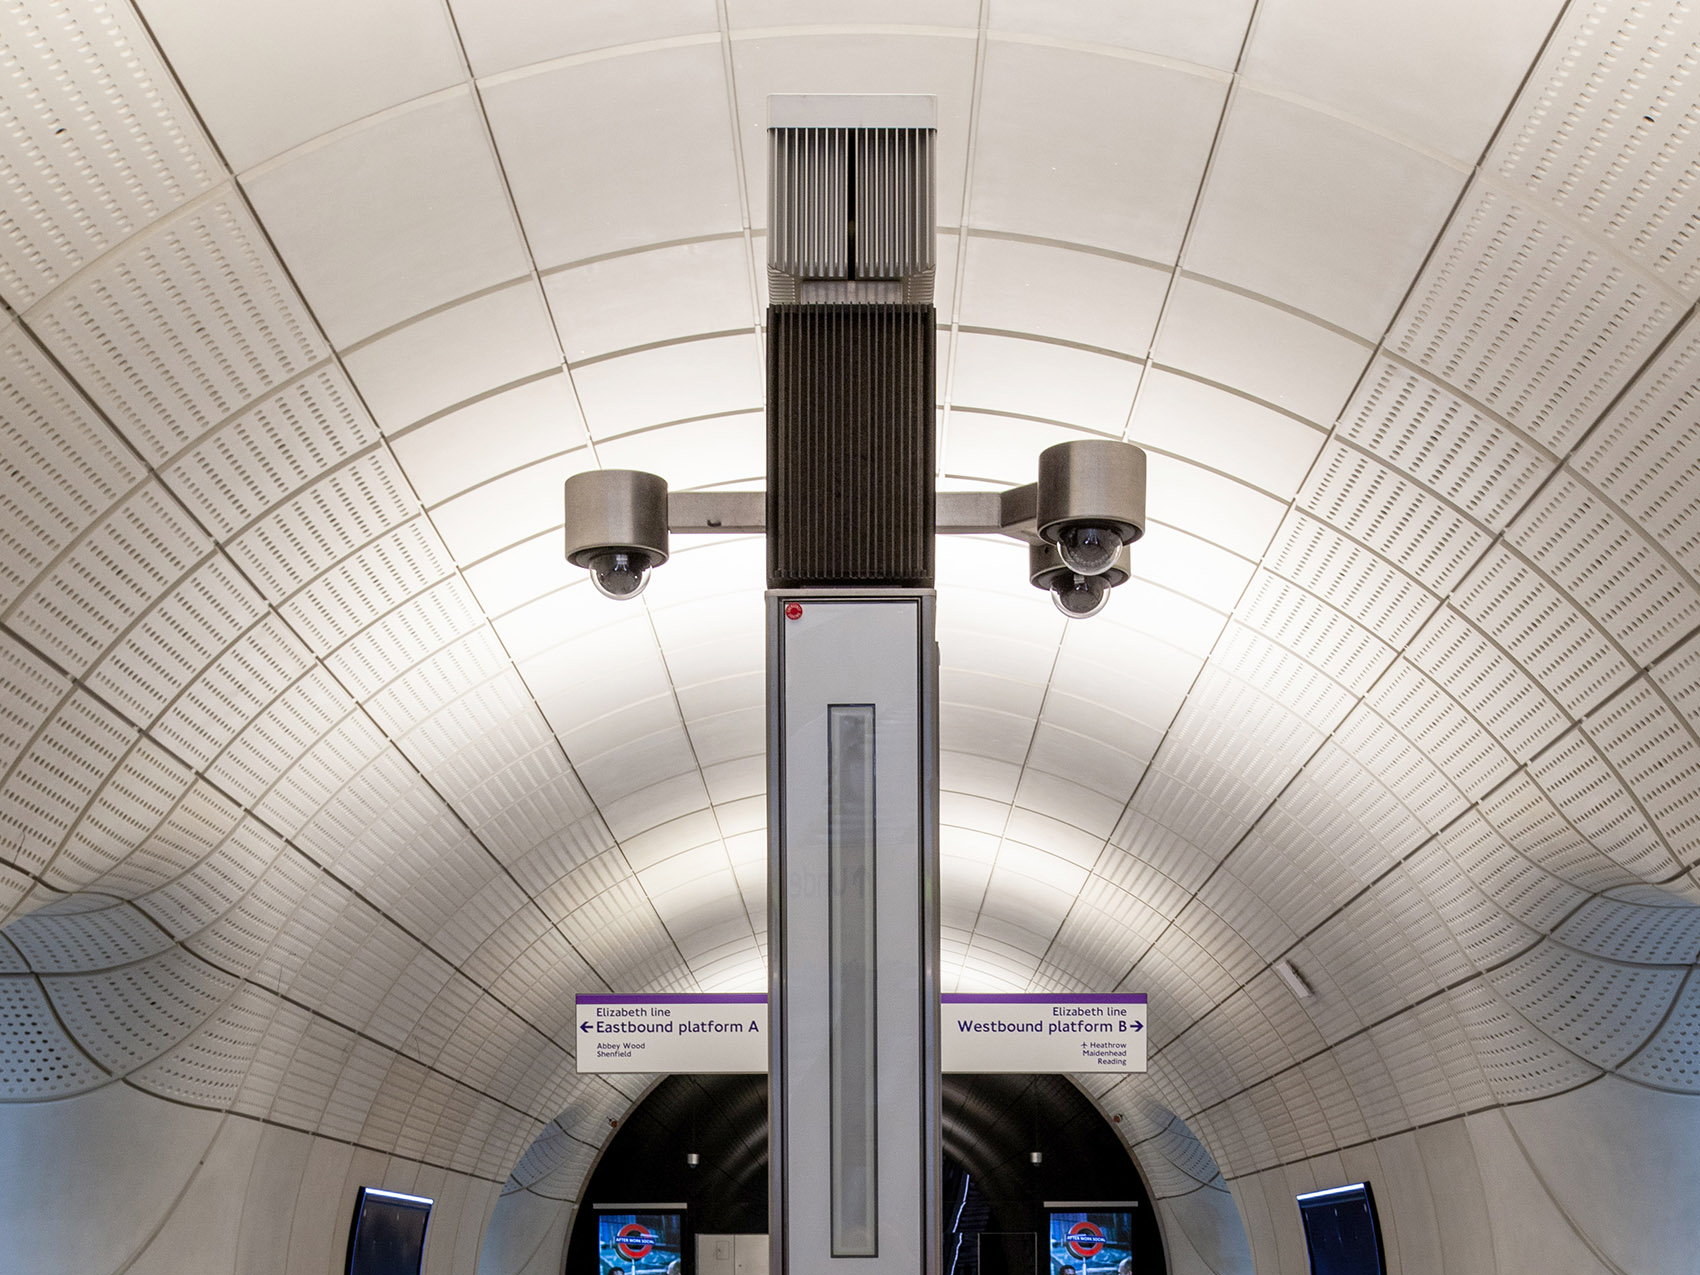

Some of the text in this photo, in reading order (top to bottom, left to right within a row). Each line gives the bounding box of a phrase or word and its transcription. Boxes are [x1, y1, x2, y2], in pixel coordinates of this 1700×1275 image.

[596, 1007, 671, 1017] Elizabeth line
[1052, 1006, 1127, 1016] Elizabeth line
[596, 1020, 760, 1035] Eastbound platform A
[957, 1020, 1127, 1035] Westbound platform B
[597, 1042, 646, 1050] Abbey Wood
[1090, 1041, 1127, 1049] Heathrow
[596, 1050, 632, 1058] Shenfield
[1082, 1049, 1127, 1057] Maidenhead
[1097, 1057, 1127, 1066] Reading
